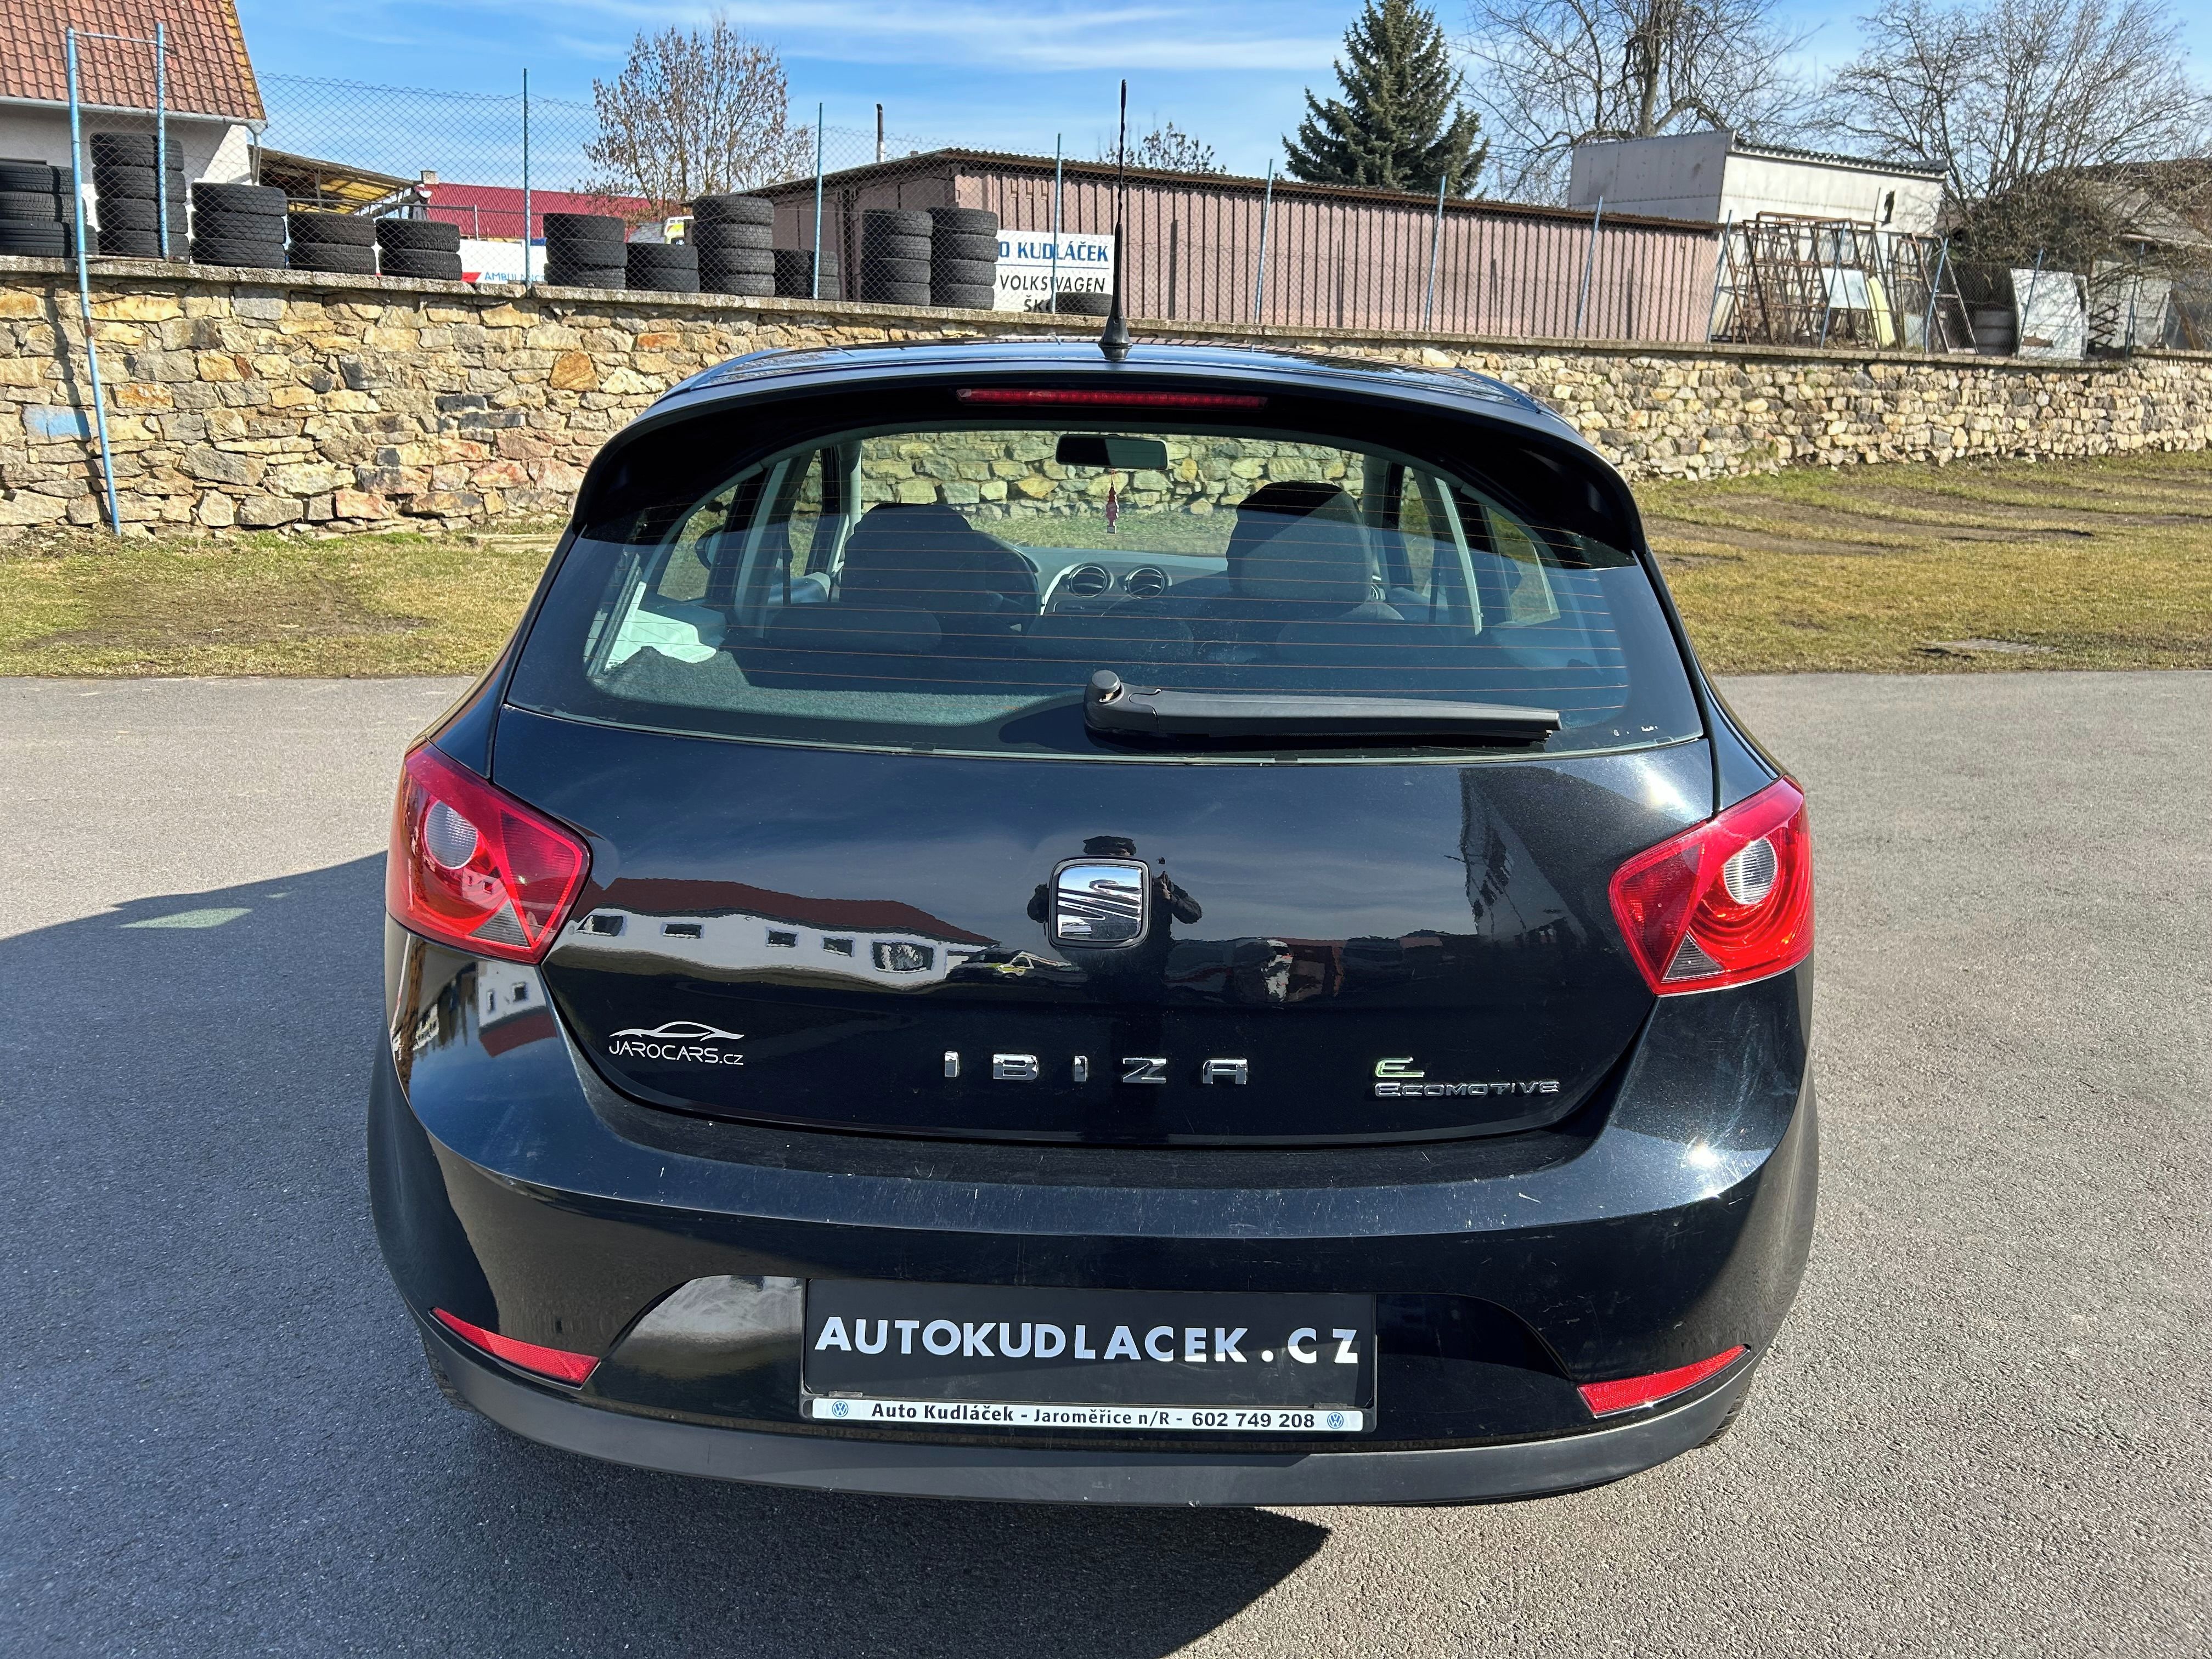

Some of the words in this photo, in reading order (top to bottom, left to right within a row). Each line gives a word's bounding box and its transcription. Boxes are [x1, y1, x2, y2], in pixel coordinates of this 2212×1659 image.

[1018, 241, 1109, 262] KUDLÁČEK
[1000, 275, 1105, 292] VOLKSWAGEN
[944, 1051, 1248, 1085] IBIZA
[872, 1403, 917, 1418] Auto
[924, 1404, 1013, 1421] Kudláček
[1034, 1409, 1131, 1424] Jaroměřice
[1138, 1410, 1170, 1427] n/R
[1192, 1412, 1228, 1427] 602
[1235, 1413, 1271, 1427] 749
[1278, 1413, 1314, 1428] 208
